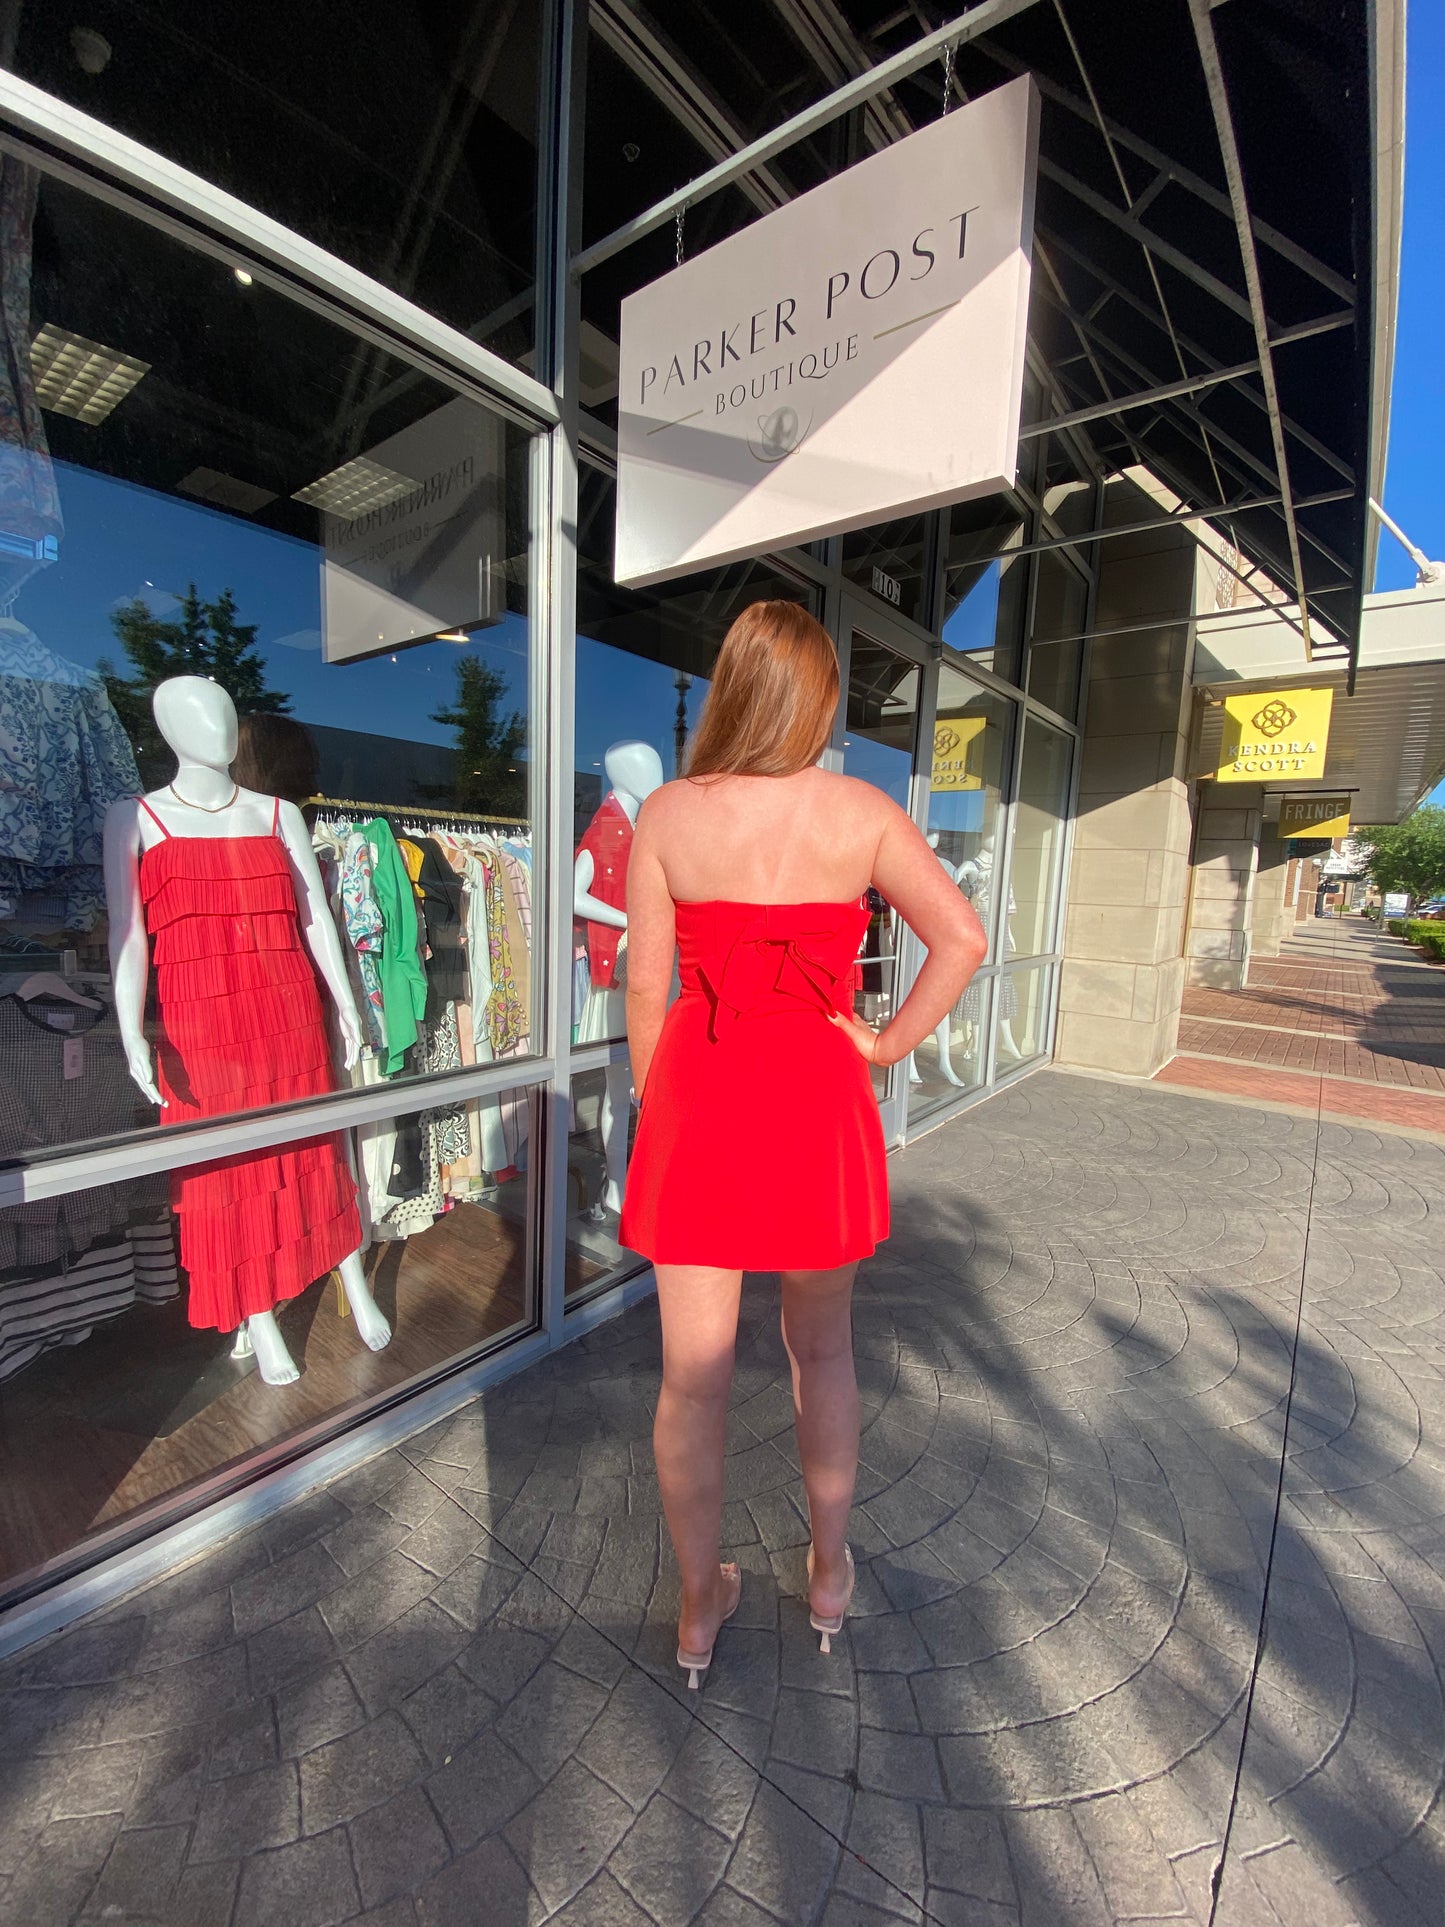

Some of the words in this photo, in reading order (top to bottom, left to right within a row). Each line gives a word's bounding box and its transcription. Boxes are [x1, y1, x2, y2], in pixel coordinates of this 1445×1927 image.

[641, 298, 797, 405] PARKER
[826, 206, 980, 319] POST
[716, 334, 859, 415] BOUTIQUE
[1228, 742, 1316, 757] KENDRA
[1232, 759, 1307, 773] SCOTT
[1285, 803, 1345, 820] FRINGE
